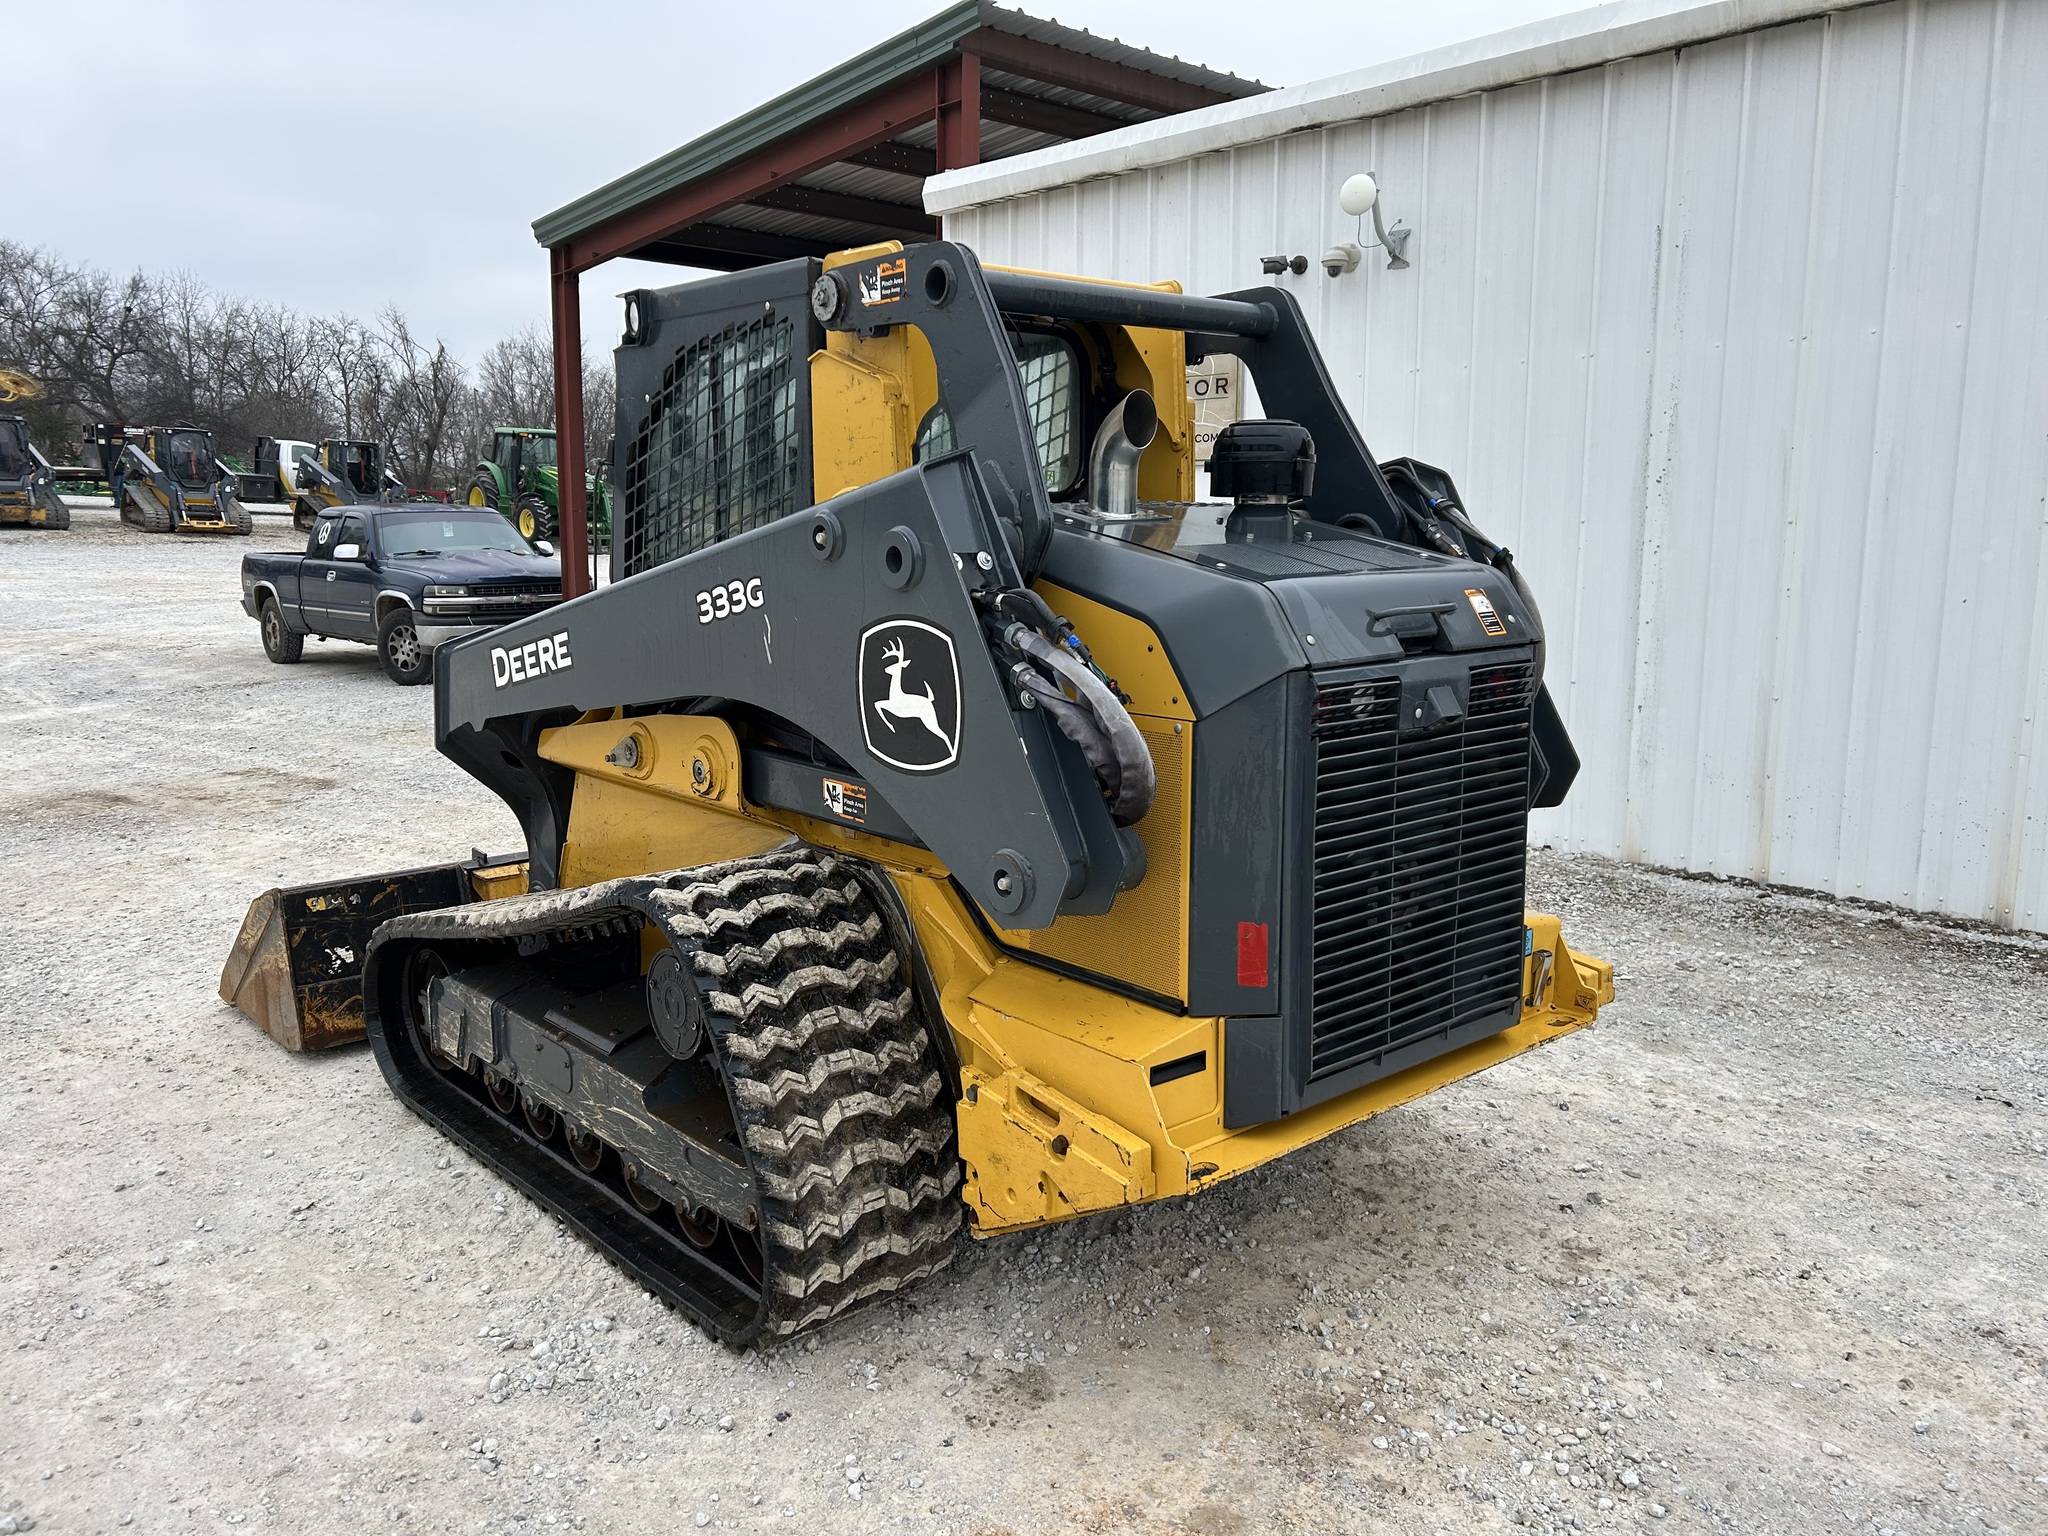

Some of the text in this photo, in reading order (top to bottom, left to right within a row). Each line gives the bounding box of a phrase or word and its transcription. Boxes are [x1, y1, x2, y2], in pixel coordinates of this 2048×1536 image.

[1186, 378, 1228, 396] OR
[696, 577, 765, 623] 333G
[491, 631, 572, 688] DEERE
